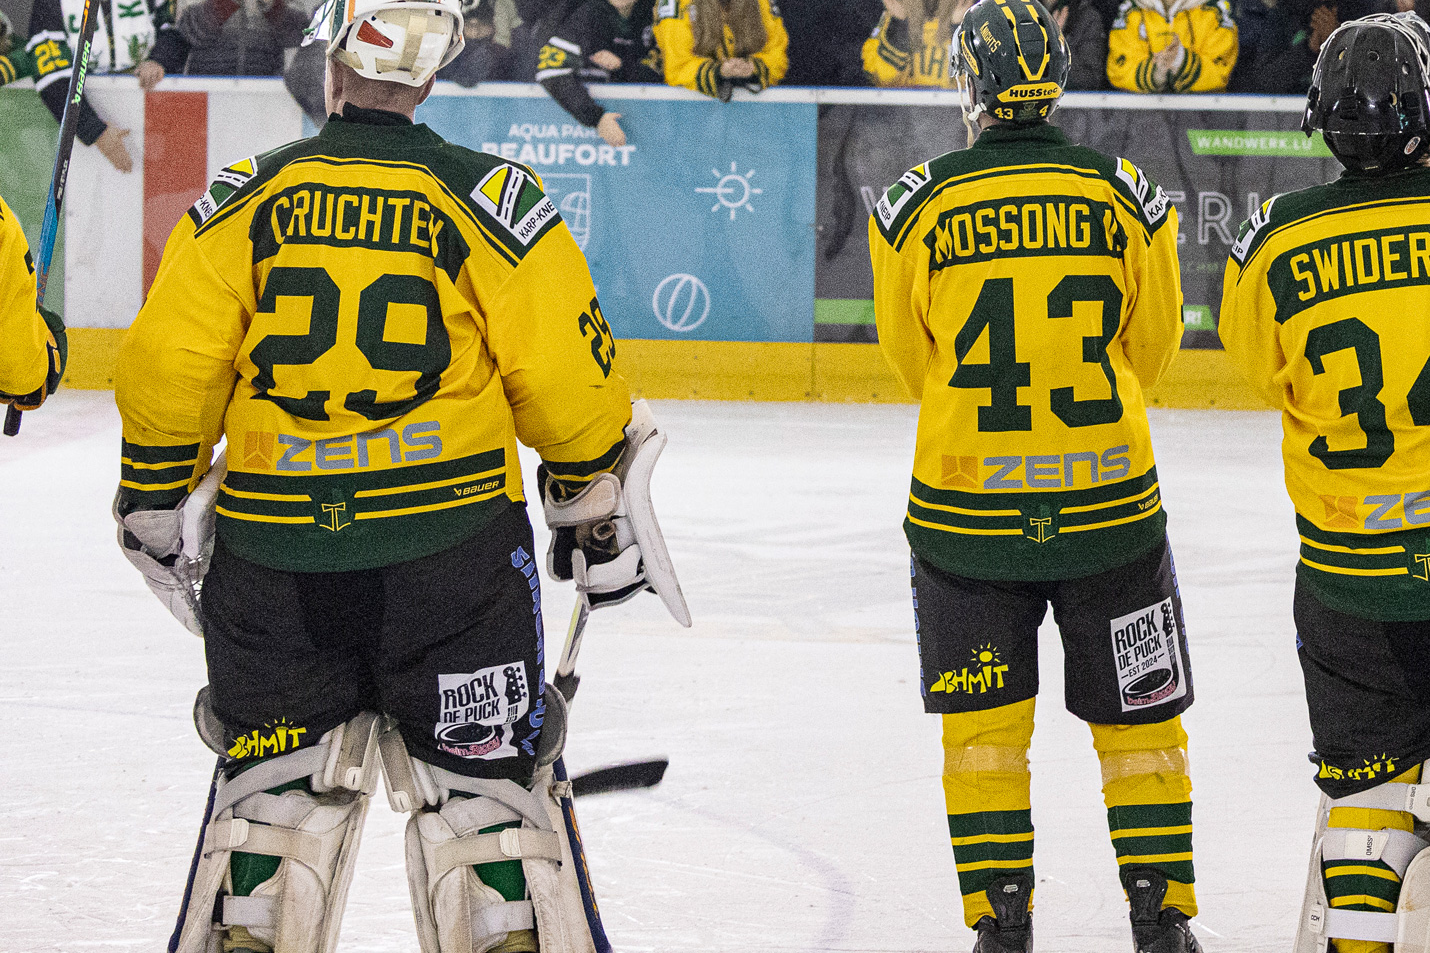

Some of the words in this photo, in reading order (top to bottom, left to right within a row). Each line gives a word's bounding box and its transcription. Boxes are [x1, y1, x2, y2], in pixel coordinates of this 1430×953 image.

[980, 20, 1002, 54] KNIGHTS
[75, 40, 91, 93] BAUER
[1009, 87, 1059, 99] HUSStec
[994, 107, 1014, 120] 43
[1038, 104, 1050, 118] 4
[508, 123, 560, 142] AQUA
[1196, 136, 1313, 151] WANDWERK.LU
[248, 266, 453, 423] 29
[947, 273, 1124, 433] 43
[1114, 609, 1159, 654] ROCK
[1117, 650, 1133, 672] DE
[1134, 633, 1162, 663] PUCK
[1128, 665, 1142, 678] EST
[1141, 655, 1159, 672] 2024
[443, 671, 501, 711] ROCK
[464, 698, 501, 724] PUCK
